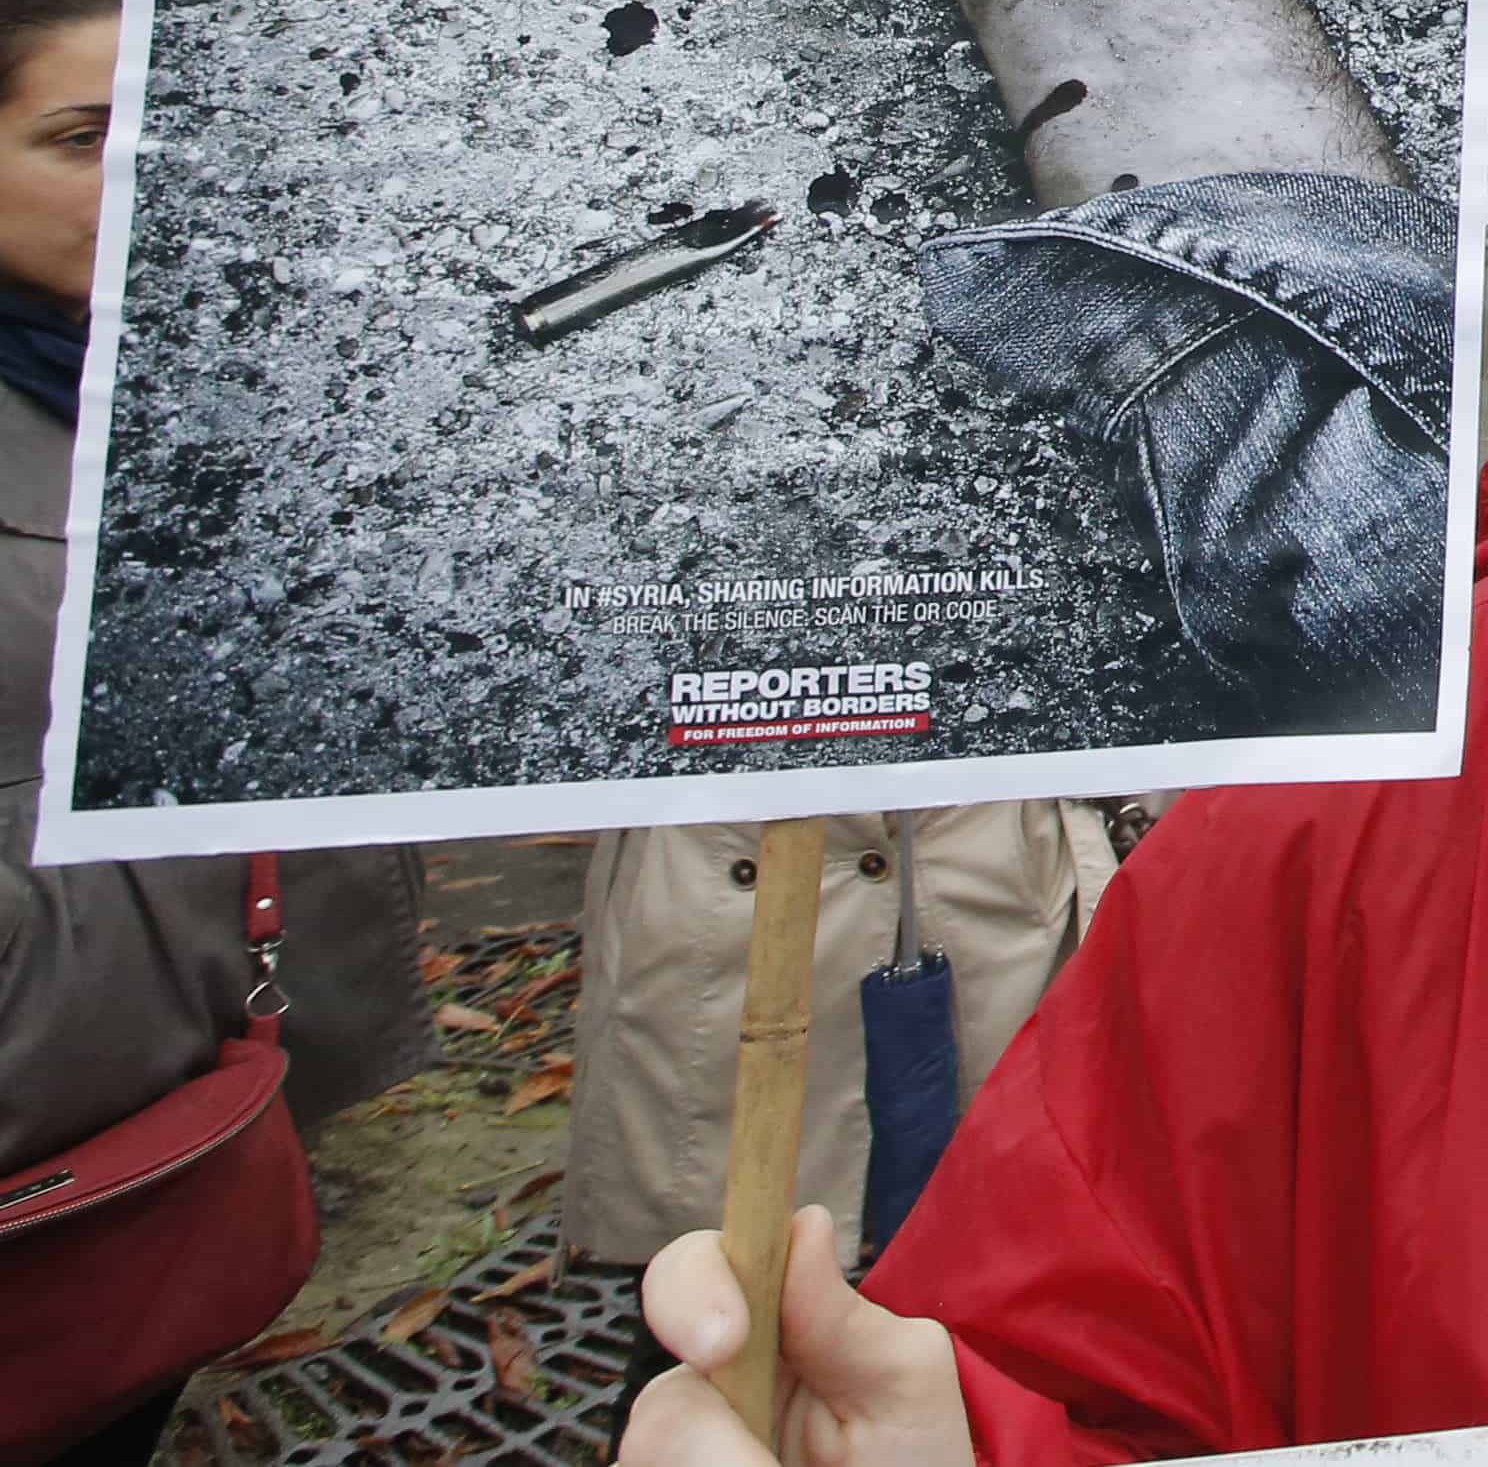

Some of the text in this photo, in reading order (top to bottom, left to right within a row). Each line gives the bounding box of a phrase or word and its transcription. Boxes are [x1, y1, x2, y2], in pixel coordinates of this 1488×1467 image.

[565, 568, 1050, 609] IN #SYRIA, SHARING INFORMATION KILLS.
[612, 615, 675, 635] BREAK
[681, 611, 719, 631] THE
[814, 604, 867, 626] SCAN
[871, 602, 909, 623] THE
[913, 601, 941, 622] QR
[671, 661, 932, 703] REPORTERS
[672, 692, 930, 724] WITHOUT BORDERS
[683, 718, 916, 742] FOR FREEDOM OF INFORMATION
